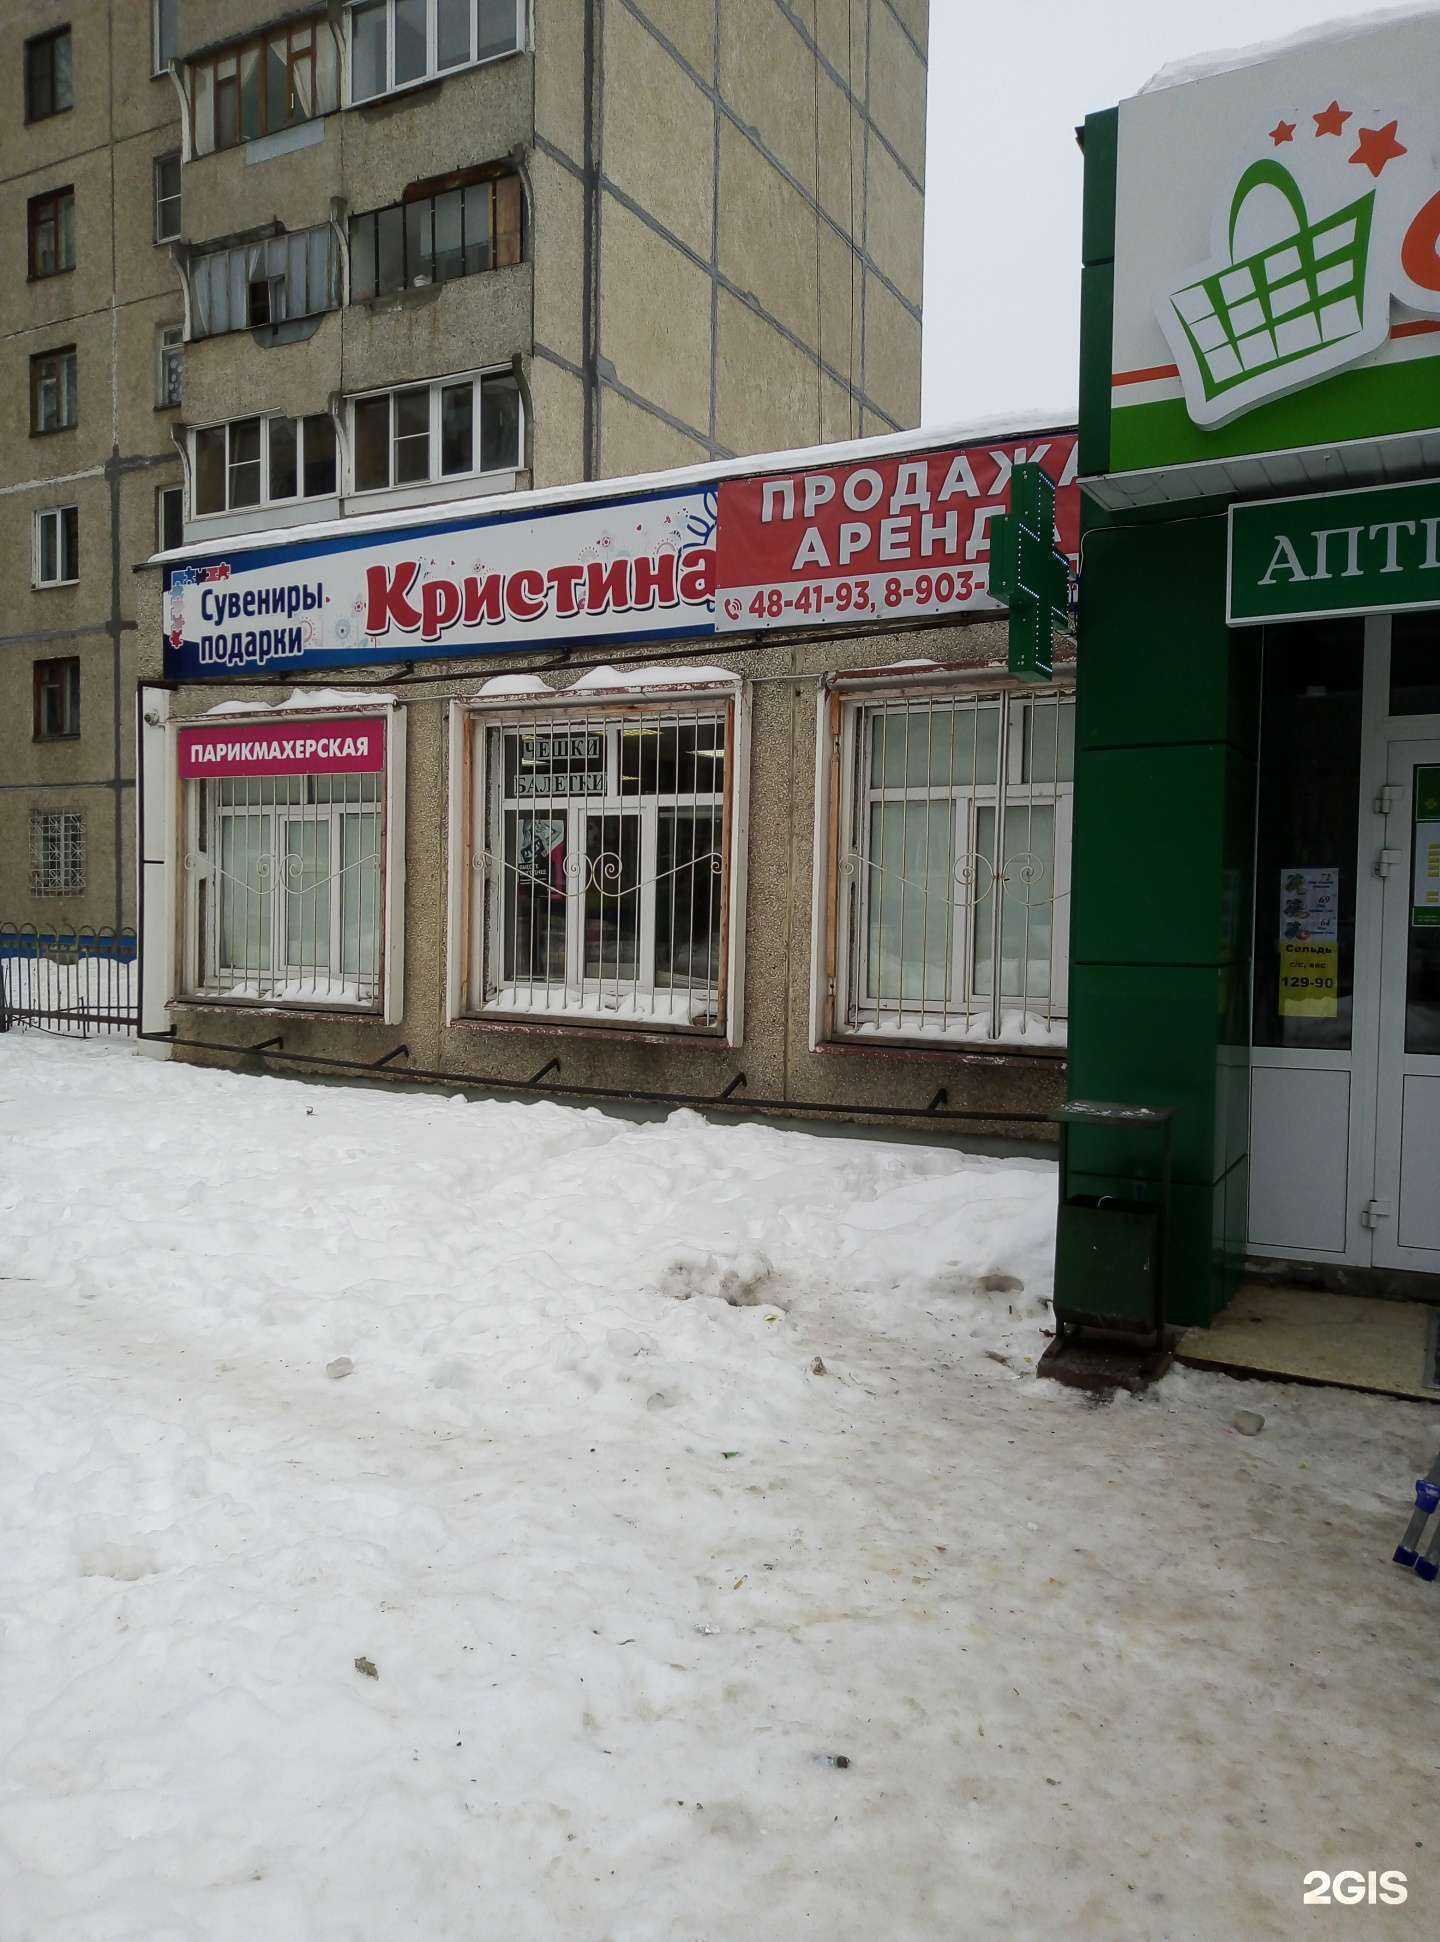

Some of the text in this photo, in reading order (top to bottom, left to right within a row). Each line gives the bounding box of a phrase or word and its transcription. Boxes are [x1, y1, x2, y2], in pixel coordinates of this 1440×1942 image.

[792, 504, 1061, 570] АРЕНД
[201, 582, 323, 626] Сувениры
[365, 548, 717, 638] Кристина
[200, 626, 303, 665] подарки
[190, 736, 369, 763] ПАРИКМАХЕРСКАЯ
[525, 739, 600, 758] ЧЕШКИ
[515, 773, 606, 794] БАЛЕТКИ
